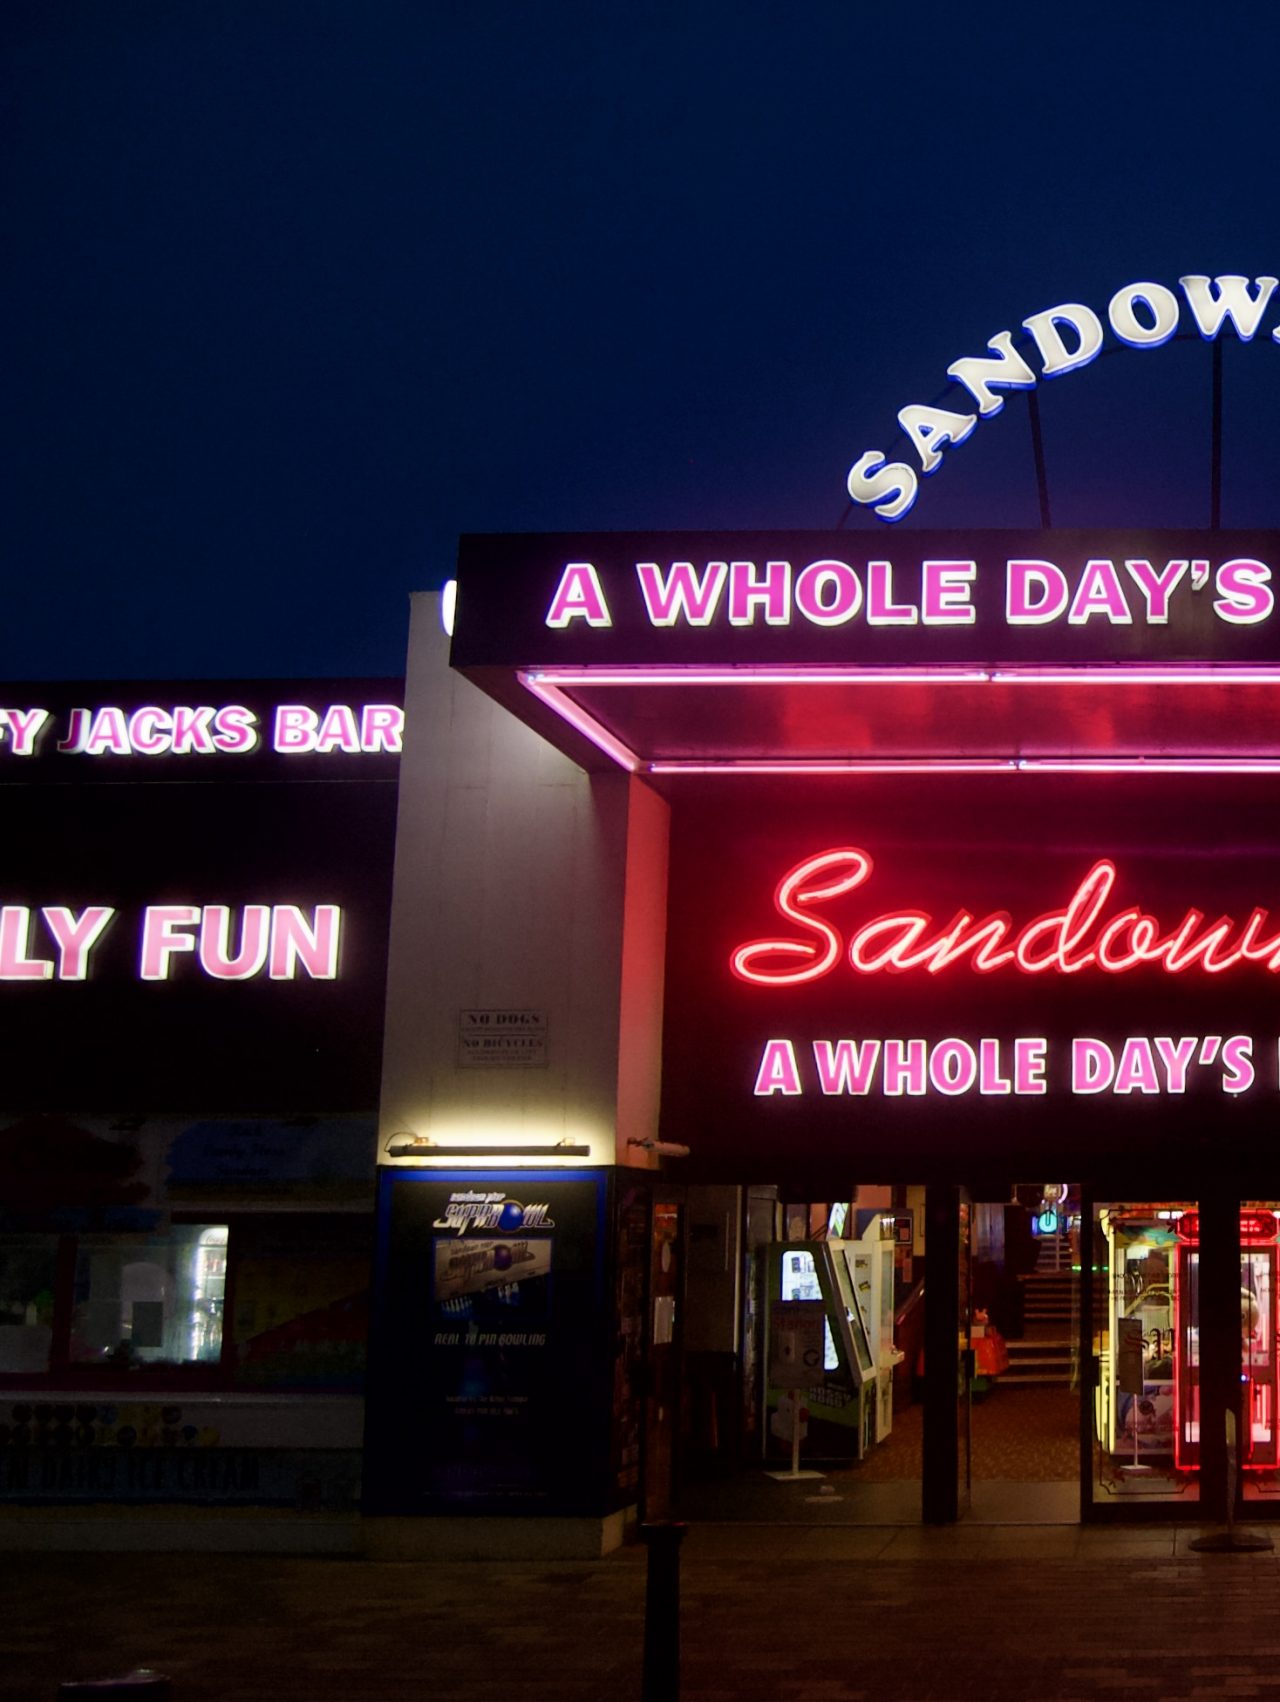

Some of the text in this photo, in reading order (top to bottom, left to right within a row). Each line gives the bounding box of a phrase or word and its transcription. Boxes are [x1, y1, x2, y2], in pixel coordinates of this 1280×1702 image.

[546, 562, 612, 628] A
[636, 560, 976, 627] WHOLE
[1005, 559, 1274, 626] DAY'S
[0, 704, 405, 756] Y JACKS BAR
[140, 904, 342, 981] FUN
[754, 1039, 802, 1096] A
[813, 1037, 1047, 1096] WHOLE
[1072, 1036, 1255, 1094] DAY'S
